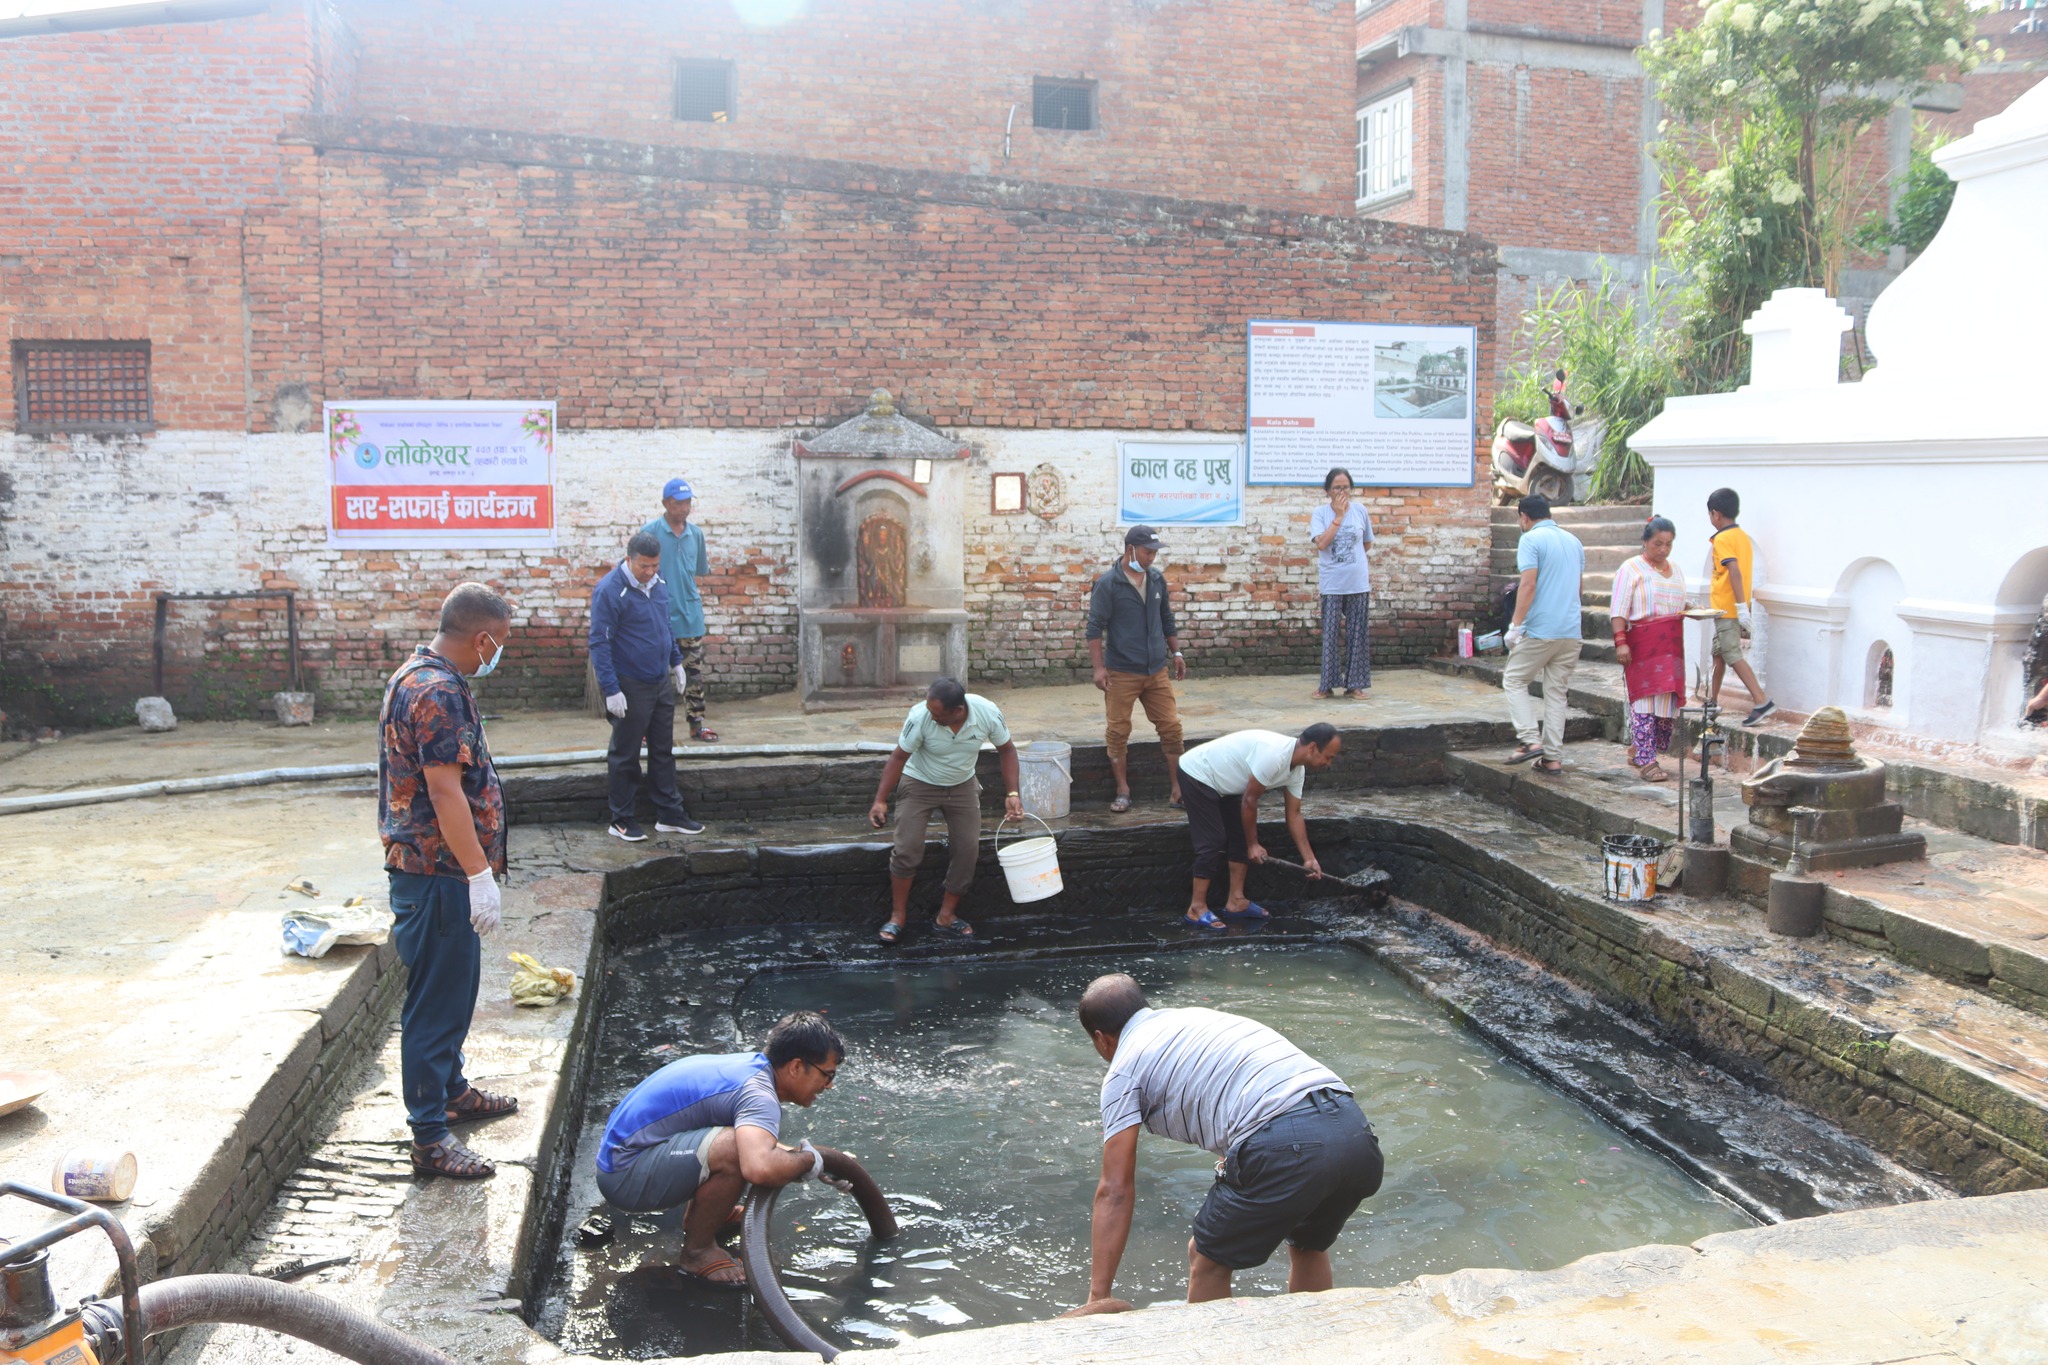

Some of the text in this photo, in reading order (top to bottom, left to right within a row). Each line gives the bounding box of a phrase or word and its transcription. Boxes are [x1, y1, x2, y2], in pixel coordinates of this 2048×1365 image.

[1283, 418, 1299, 426] Daha
[384, 439, 472, 466] लोकेश्वर
[1131, 458, 1231, 486] काल दह पुखु
[452, 490, 538, 520] कार्यक्रम
